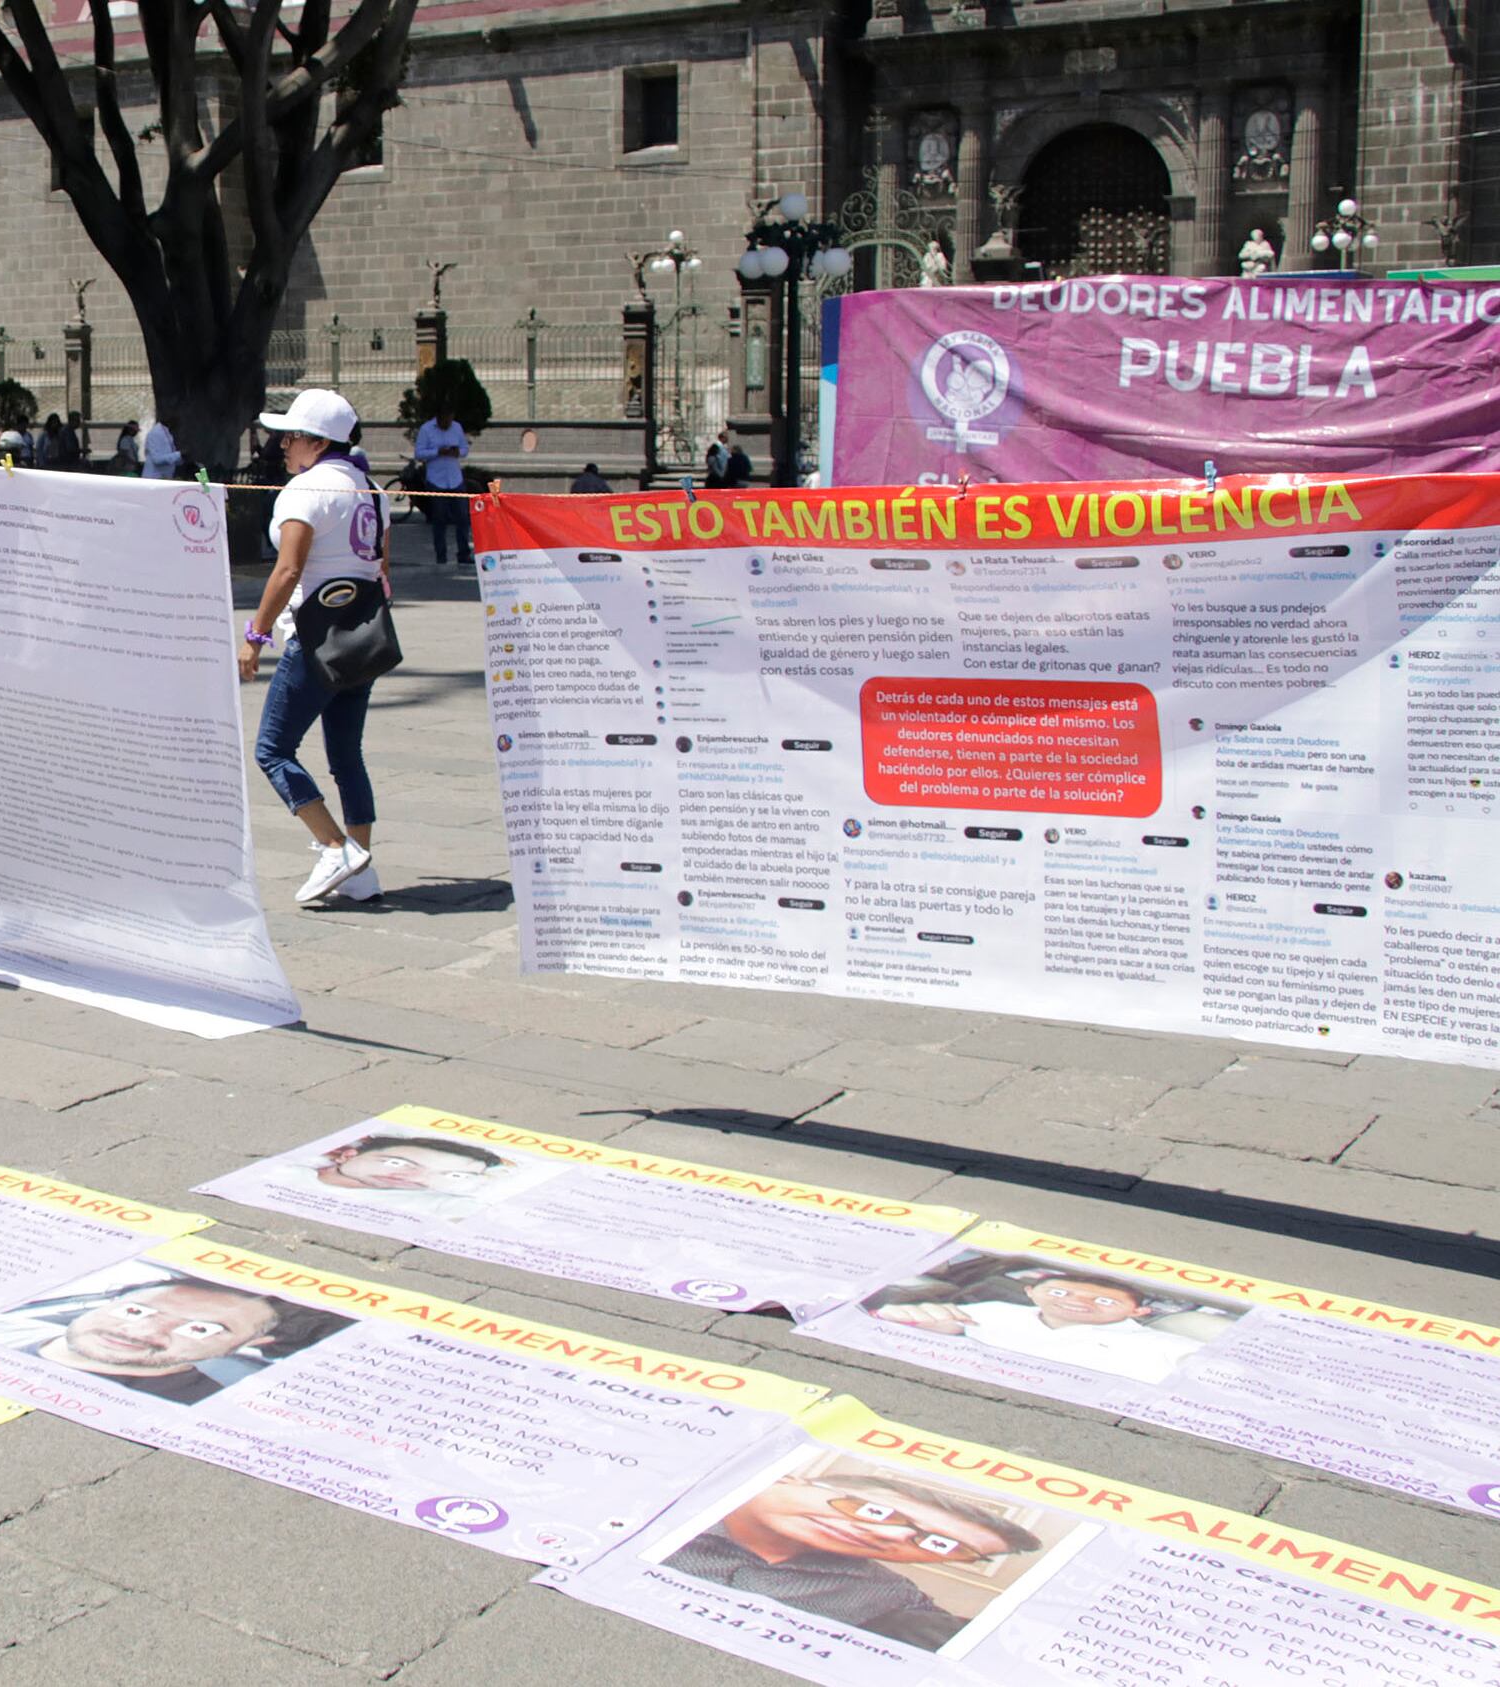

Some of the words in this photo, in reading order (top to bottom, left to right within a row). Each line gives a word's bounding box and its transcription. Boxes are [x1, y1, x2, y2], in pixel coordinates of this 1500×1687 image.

[994, 285, 1206, 321] DEUDORES
[1118, 336, 1378, 399] PUEBLA
[611, 503, 722, 543] ESTO
[730, 487, 957, 541] TAMBIÉN
[975, 497, 1032, 541] ES
[1047, 482, 1363, 540] VIOLENCIA
[183, 544, 217, 555] PUEBLA
[756, 616, 780, 626] Sras
[783, 615, 816, 626] abren
[818, 615, 836, 626] los
[839, 615, 865, 630] pies
[867, 619, 874, 629] y
[877, 615, 910, 631] luego
[912, 617, 928, 626] no
[931, 618, 945, 626] se
[958, 611, 982, 624] Que
[984, 613, 998, 622] se
[1001, 611, 1033, 624] dejen
[1036, 611, 1051, 623] de
[1054, 611, 1112, 623] alborotos
[1115, 612, 1150, 622] eatas
[759, 631, 808, 643] entiende
[811, 634, 818, 644] y
[821, 632, 866, 645] quieren
[868, 631, 916, 646] pensión
[919, 632, 953, 646] piden
[961, 627, 1011, 640] mujeres,
[1014, 628, 1040, 640] para
[1045, 628, 1067, 637] eso
[1070, 625, 1103, 638] están
[1105, 626, 1124, 637] las
[760, 648, 809, 663] igualdad
[813, 648, 827, 660] de
[830, 648, 870, 663] género
[872, 651, 879, 662] y
[882, 649, 915, 663] luego
[918, 649, 950, 661] salen
[963, 642, 1021, 653] instancias
[1024, 642, 1069, 657] legales.
[761, 666, 782, 675] con
[785, 665, 817, 676] estás
[820, 666, 854, 676] cosas
[964, 658, 987, 669] Con
[990, 660, 1020, 671] estar
[1022, 660, 1037, 672] de
[1039, 660, 1085, 675] gritonas
[1088, 662, 1112, 675] que
[1117, 661, 1160, 674] ganan?
[876, 690, 915, 705] Detrás
[917, 692, 933, 705] de
[936, 693, 963, 706] cada
[967, 696, 991, 706] uno
[995, 695, 1011, 707] de
[1013, 697, 1045, 707] estos
[1048, 698, 1107, 712] mensajes
[1110, 697, 1138, 711] está
[881, 712, 896, 721] un
[899, 710, 967, 724] violentador
[971, 715, 979, 724] o
[982, 712, 1037, 729] cómplice
[1040, 715, 1059, 728] del
[1062, 716, 1110, 729] mismo.
[1113, 716, 1134, 730] Los
[898, 727, 953, 741] deudores
[956, 729, 1034, 746] denunciados
[1037, 735, 1054, 745] no
[1057, 732, 1119, 747] necesitan
[884, 743, 953, 761] defenderse,
[957, 746, 996, 762] tienen
[999, 753, 1006, 762] a
[1009, 750, 1042, 767] parte
[1045, 749, 1062, 764] de
[1065, 751, 1078, 765] la
[1080, 750, 1138, 766] sociedad
[879, 761, 944, 776] haciéndolo
[947, 766, 967, 781] por
[971, 764, 1001, 779] ellos.
[1005, 768, 1062, 784] ¿Quieres
[1065, 771, 1084, 782] ser
[1087, 768, 1146, 788] cómplice
[899, 780, 918, 793] del
[921, 781, 980, 799] problema
[982, 787, 991, 796] o
[994, 785, 1027, 801] parte
[1030, 784, 1046, 798] de
[1050, 785, 1061, 798] la
[1063, 785, 1124, 803] solución?
[429, 1118, 602, 1162] DEUDOR
[609, 1159, 913, 1218] ALIMENTARIO
[1028, 1237, 1256, 1295] DEUDOR
[193, 1250, 390, 1309] DEUDOR
[395, 1304, 747, 1391] ALIMENTARIO
[707, 1404, 736, 1418] N
[856, 1428, 1135, 1512] DEUDOR
[1152, 1543, 1226, 1570] Julio
[1235, 1567, 1329, 1600] César
[642, 1568, 730, 1604] Número
[735, 1600, 765, 1616] de
[678, 1600, 833, 1662] 1224/2014
